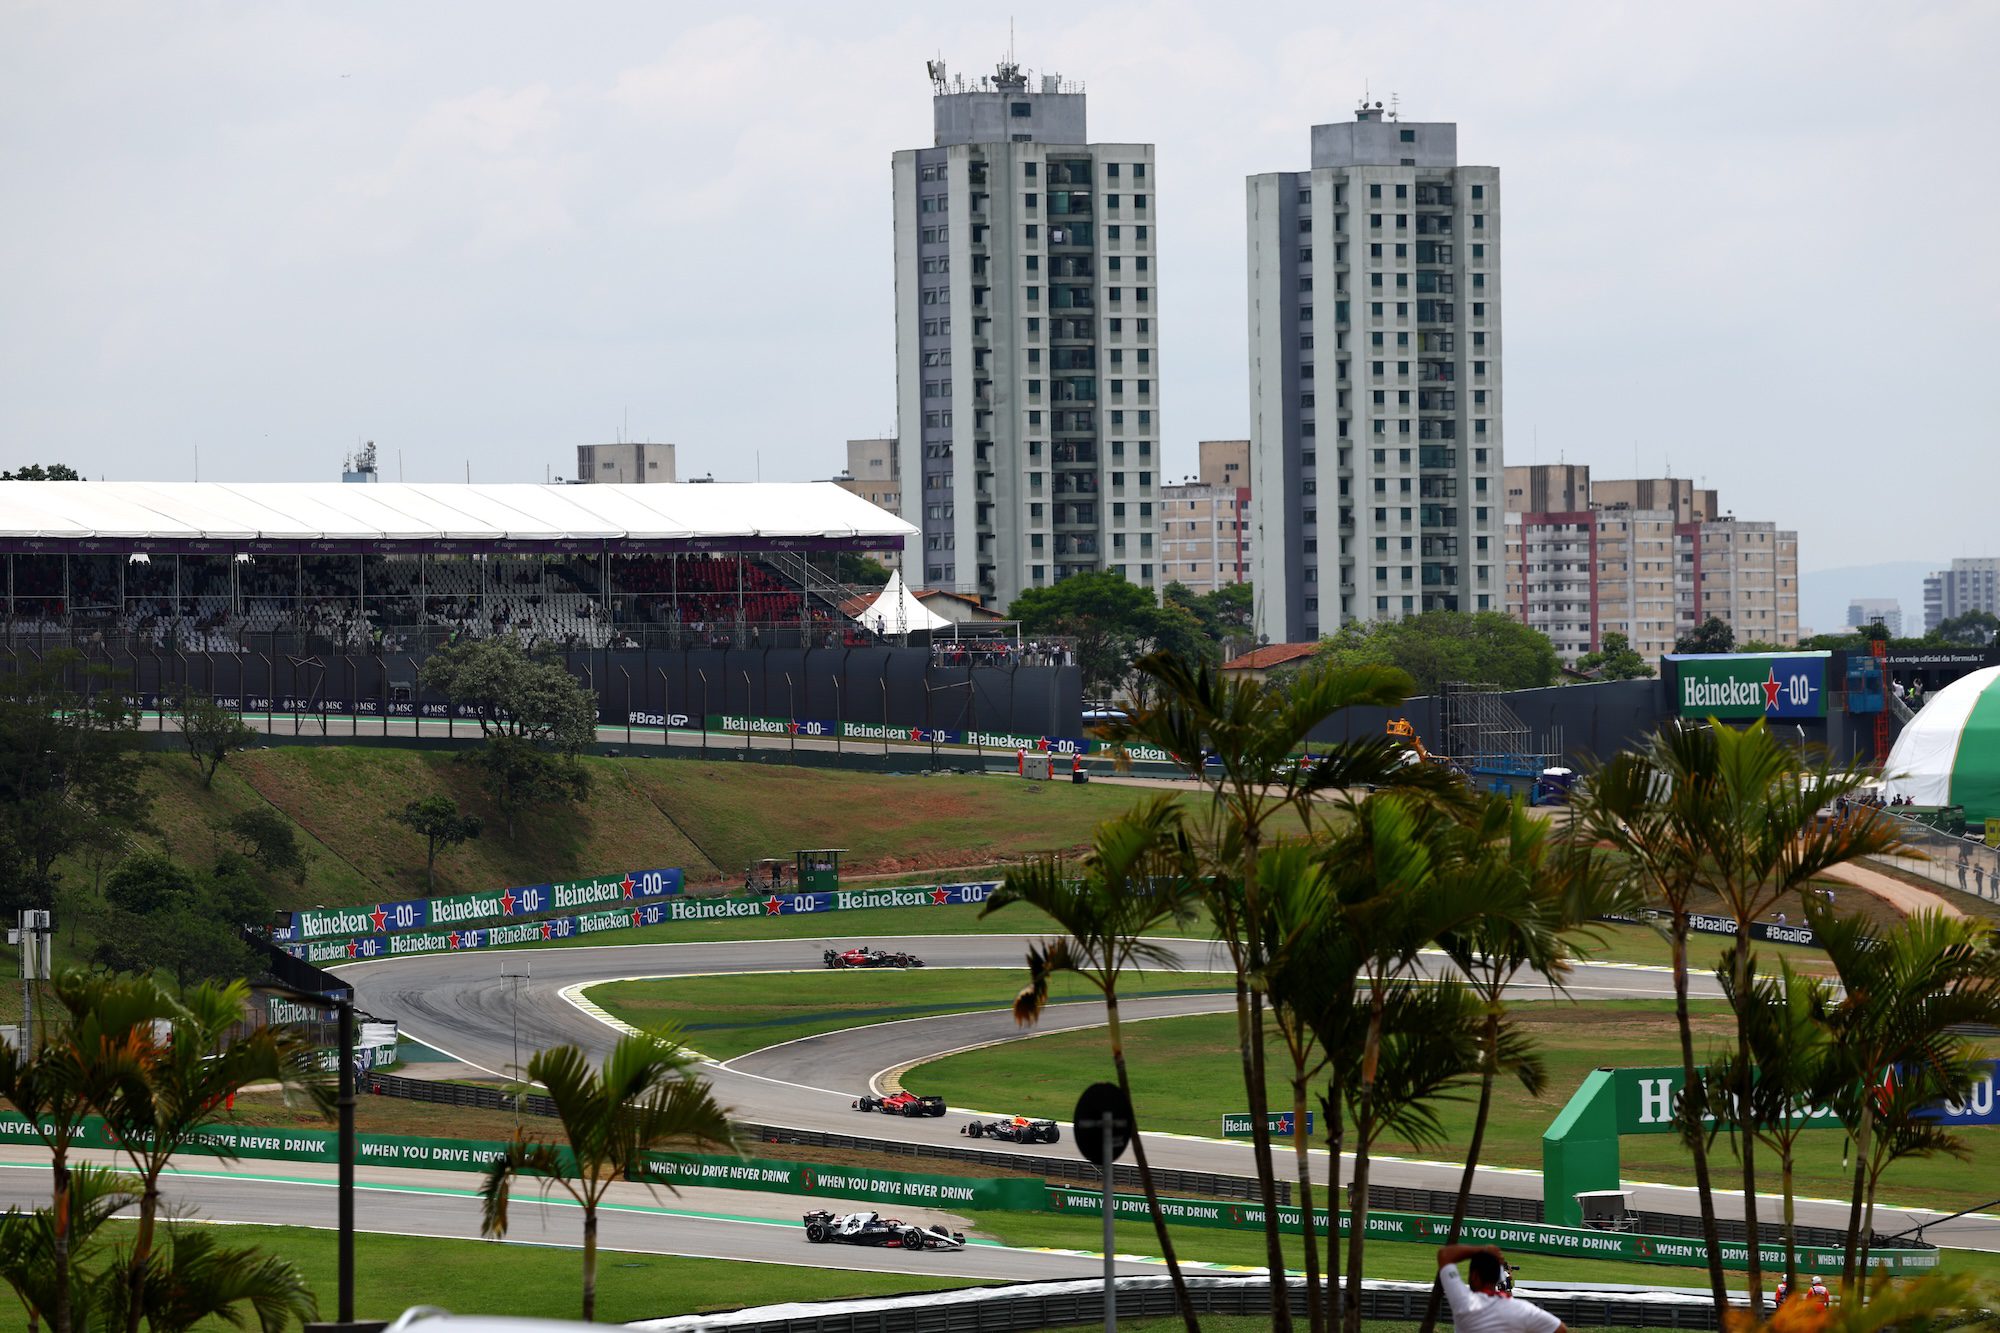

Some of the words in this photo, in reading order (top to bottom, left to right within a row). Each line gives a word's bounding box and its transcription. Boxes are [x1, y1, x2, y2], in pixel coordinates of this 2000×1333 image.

[1684, 676, 1760, 706] Heineken
[1790, 674, 1809, 706] 0.0
[224, 699, 239, 707] MSC
[326, 701, 343, 709] MSC
[359, 702, 377, 711] MSC
[396, 704, 413, 712] MSC
[430, 704, 447, 712] MSC
[722, 716, 784, 733] Heineken
[844, 722, 907, 740] Heineken
[967, 731, 1033, 749] Heineken
[554, 880, 619, 908] Heineken
[643, 872, 662, 896] 0.0
[837, 890, 926, 910] Heineken
[961, 886, 982, 903] 0.0
[431, 896, 499, 923] Heineken
[522, 889, 539, 912] 0.0
[671, 900, 760, 919] Heineken
[794, 895, 814, 912] 0.0
[301, 911, 368, 936] Heineken
[396, 904, 414, 928] 0.0
[580, 912, 629, 933] Heineken
[1689, 915, 1739, 934] #BrazilGP
[390, 933, 446, 953] Heineken
[489, 925, 540, 945] Heineken
[1766, 925, 1813, 944] #BrazilGP
[308, 943, 346, 962] Heineken
[240, 1136, 281, 1150] NEVER
[284, 1139, 326, 1153] DRINK
[362, 1143, 399, 1158] WHEN
[402, 1145, 429, 1160] YOU
[433, 1148, 469, 1162] DRIVE
[650, 1162, 677, 1175] WHEN
[680, 1163, 700, 1176] YOU
[702, 1164, 728, 1178] DRIVE
[730, 1167, 760, 1181] NEVER
[762, 1169, 790, 1183] DRINK
[818, 1175, 845, 1188] WHEN
[848, 1177, 869, 1190] YOU
[871, 1179, 901, 1194] DRIVE
[904, 1183, 938, 1198] NEVER
[941, 1186, 974, 1201] DRINK
[1067, 1196, 1095, 1209] WHEN
[1098, 1198, 1118, 1210] YU
[1122, 1200, 1150, 1213] DRIVE
[1158, 1203, 1184, 1217] EVER
[1187, 1206, 1219, 1220] DRINK
[1278, 1212, 1299, 1226] YOU
[1370, 1220, 1403, 1232] DRINK
[1433, 1224, 1468, 1238] WHN
[1471, 1227, 1497, 1240] YOU
[1500, 1230, 1536, 1244] DRIVE
[1539, 1233, 1579, 1248] NEVER
[1582, 1237, 1622, 1251] DRINK
[1656, 1243, 1692, 1257] WHEN
